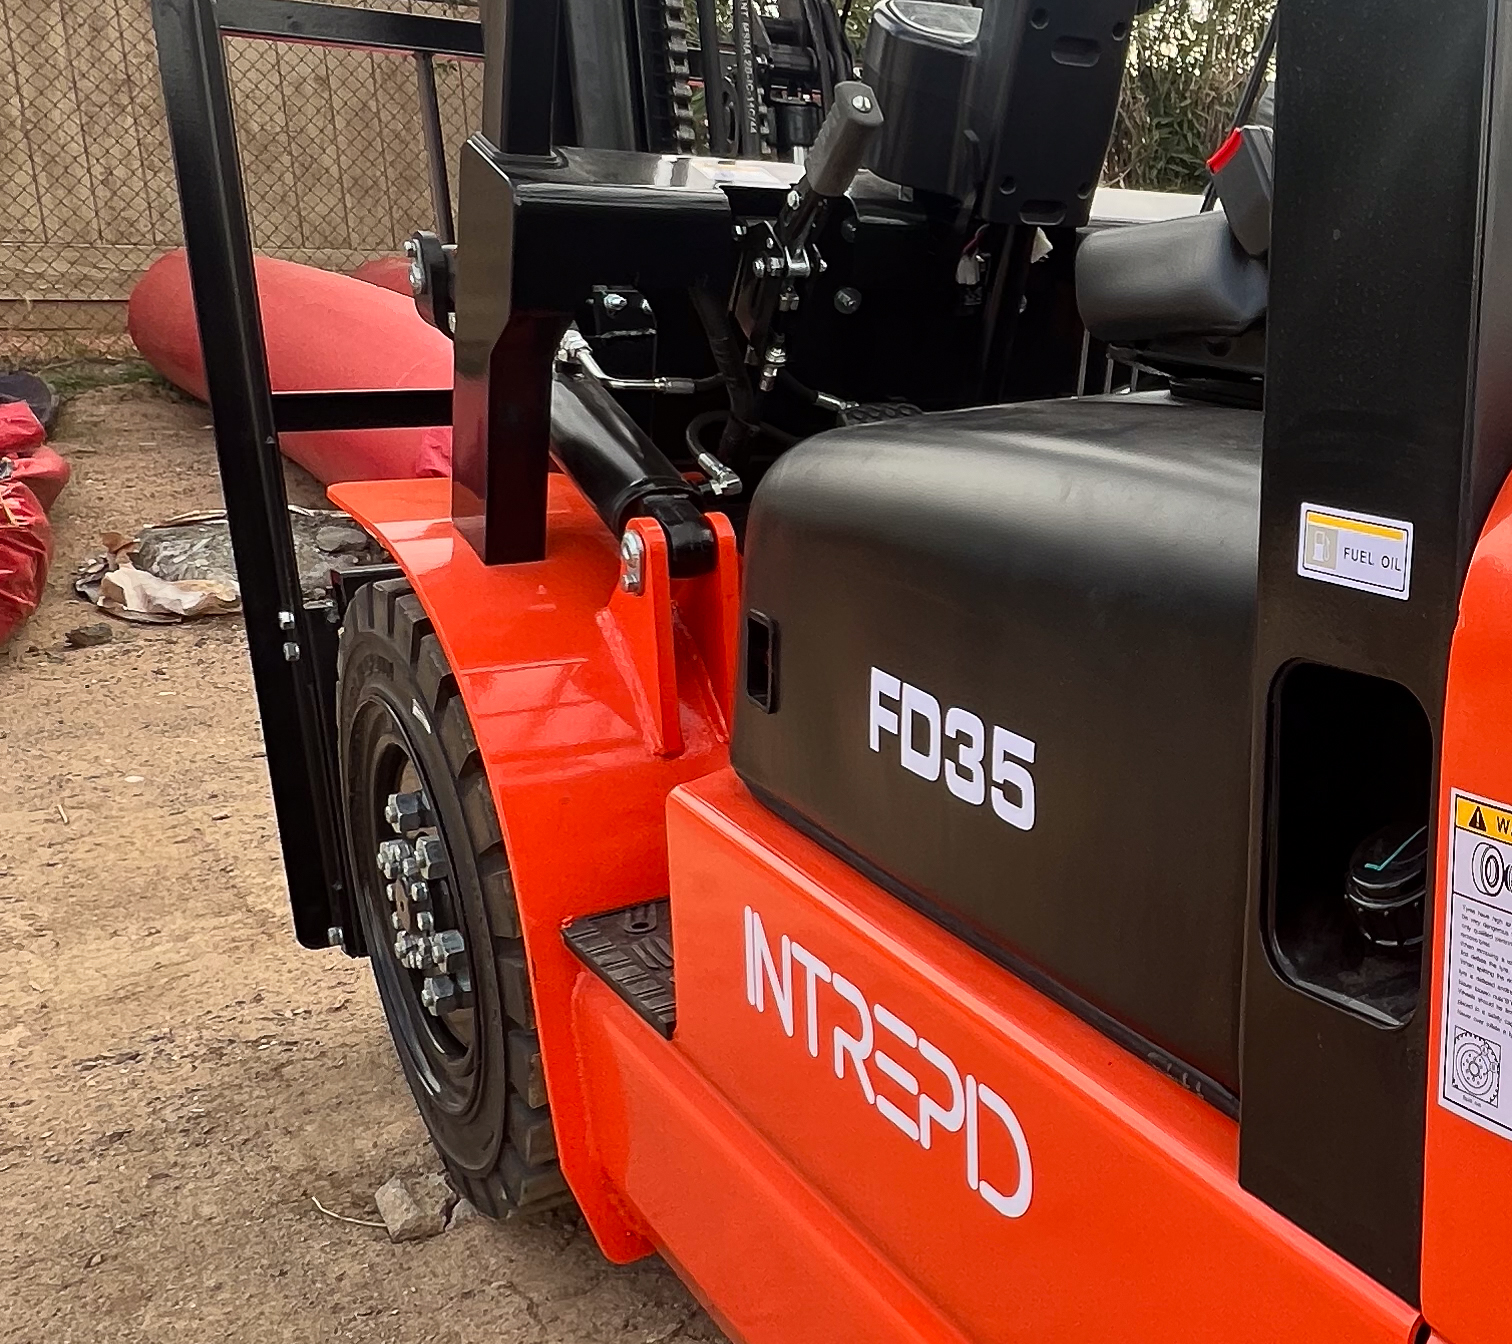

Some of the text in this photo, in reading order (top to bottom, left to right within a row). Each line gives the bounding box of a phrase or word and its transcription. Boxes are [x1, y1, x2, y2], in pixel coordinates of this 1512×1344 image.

[1343, 547, 1402, 572] FUEL OIL
[869, 666, 1036, 831] FD35
[743, 905, 1034, 1218] INTREPID
